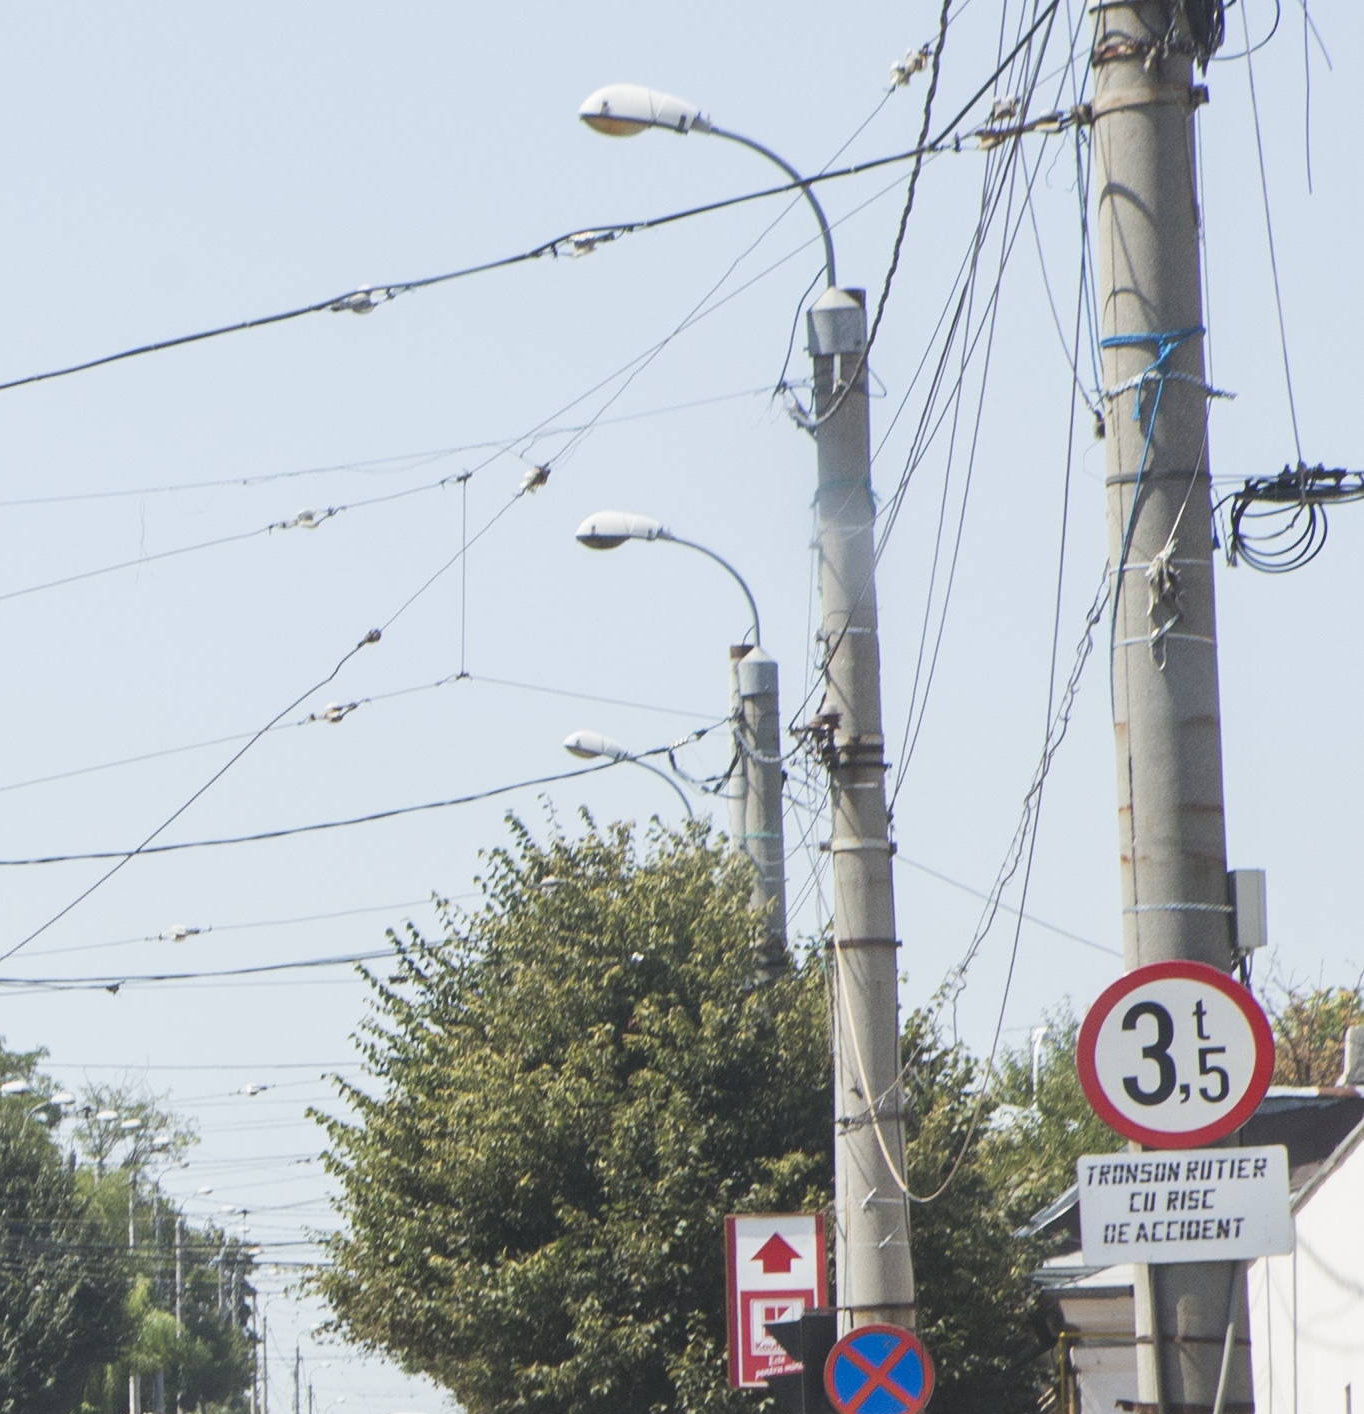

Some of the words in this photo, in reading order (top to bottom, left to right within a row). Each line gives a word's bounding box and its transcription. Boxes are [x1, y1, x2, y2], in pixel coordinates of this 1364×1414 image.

[1086, 1161, 1181, 1187] TRONSON
[1186, 1157, 1268, 1182] RUTIER
[1129, 1191, 1156, 1214] CU
[1166, 1188, 1216, 1212] RISC
[1103, 1222, 1132, 1245] DE
[1135, 1217, 1246, 1244] ACCIDENT
